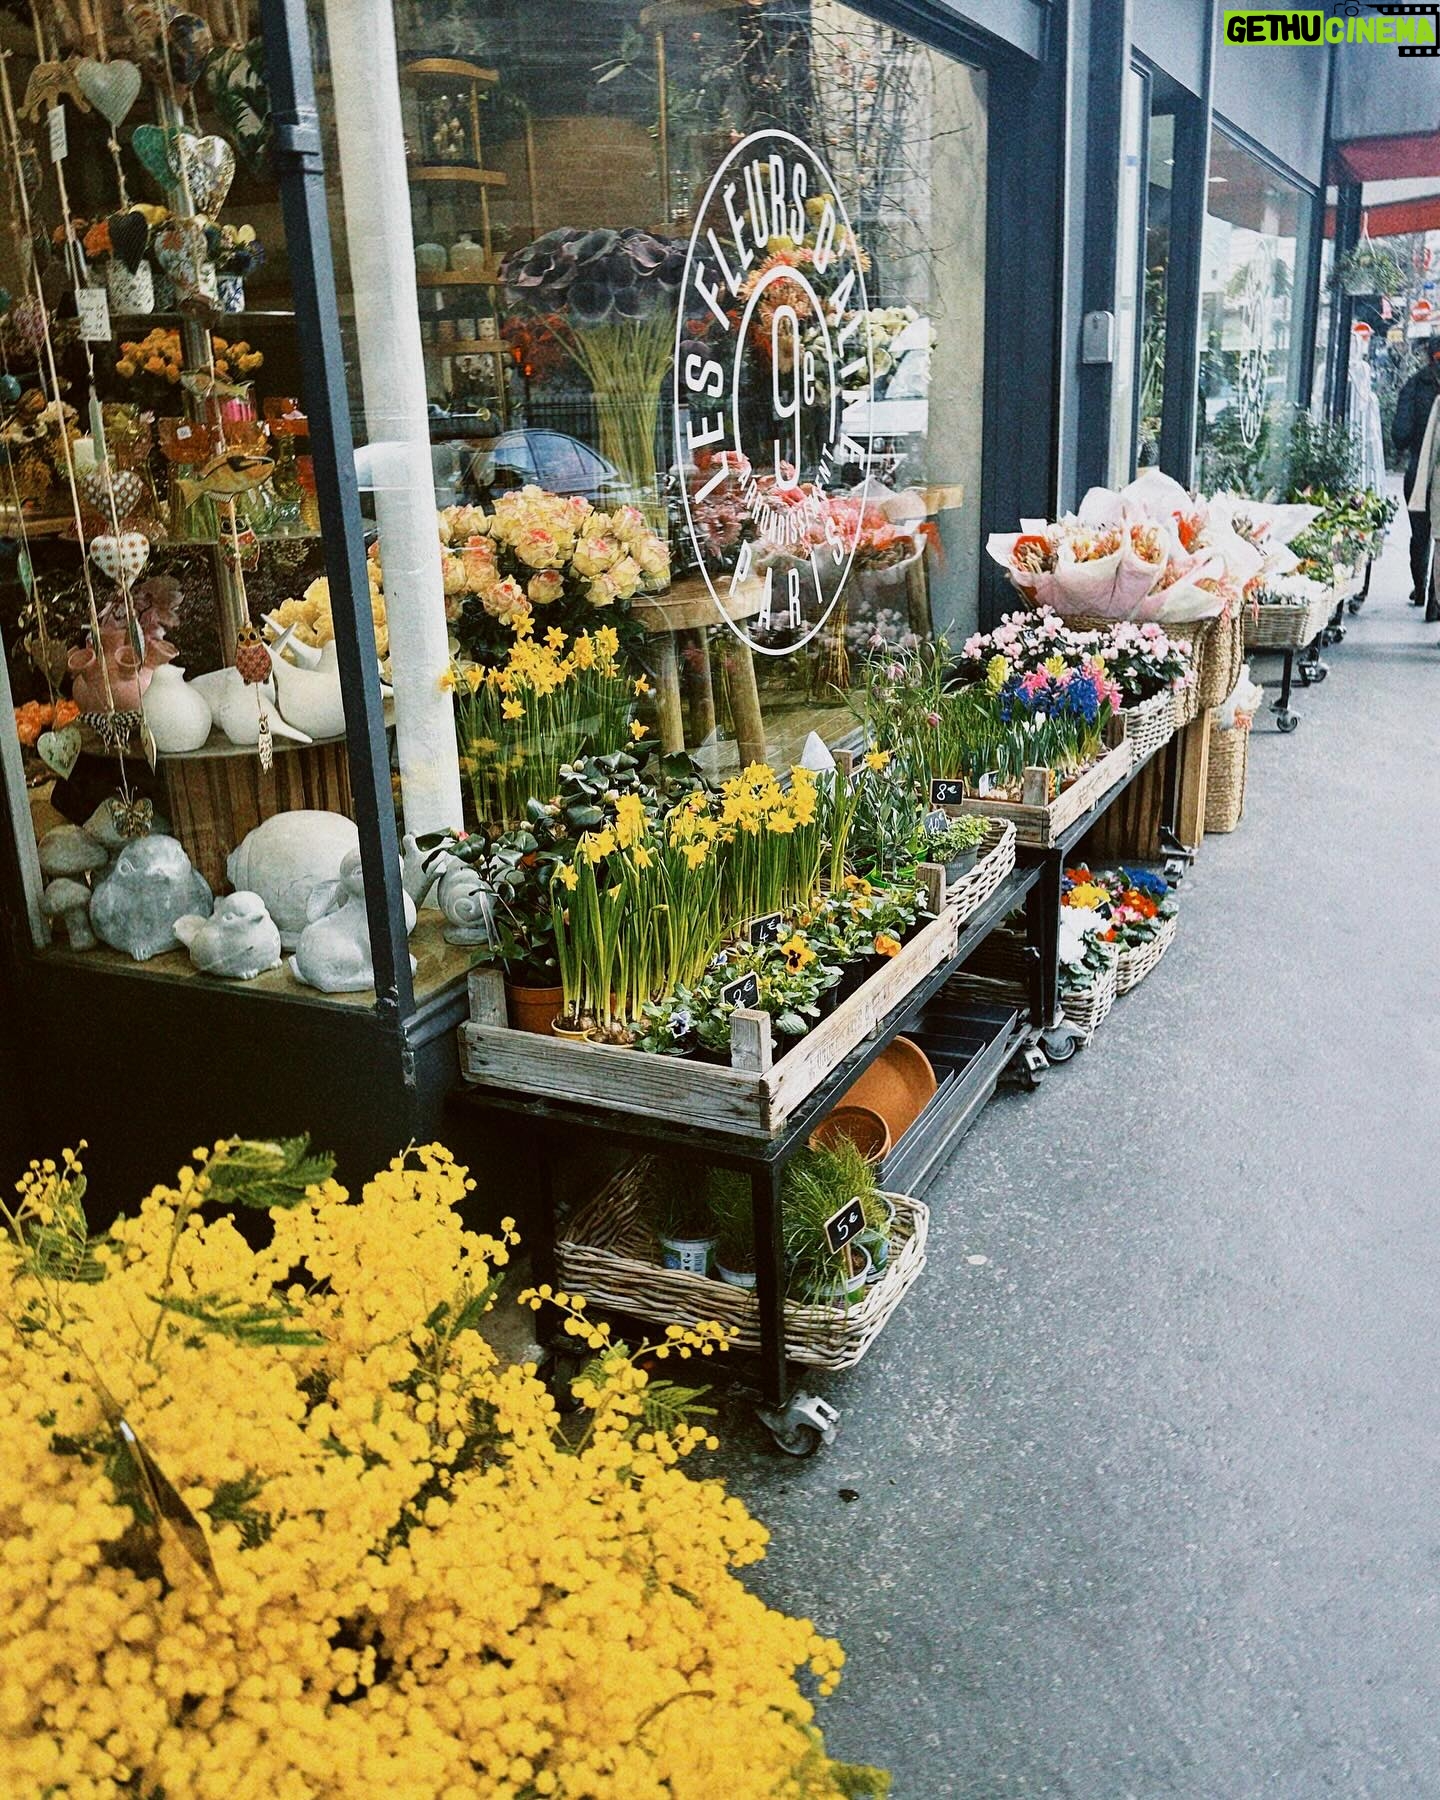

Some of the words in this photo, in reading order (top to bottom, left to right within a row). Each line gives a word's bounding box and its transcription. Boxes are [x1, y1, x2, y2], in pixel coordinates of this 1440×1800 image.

[694, 154, 807, 331] FLEURS
[812, 199, 867, 471] D'ALINE
[685, 353, 729, 505] LES
[729, 516, 845, 631] PARIS
[837, 1212, 858, 1240] 5€
